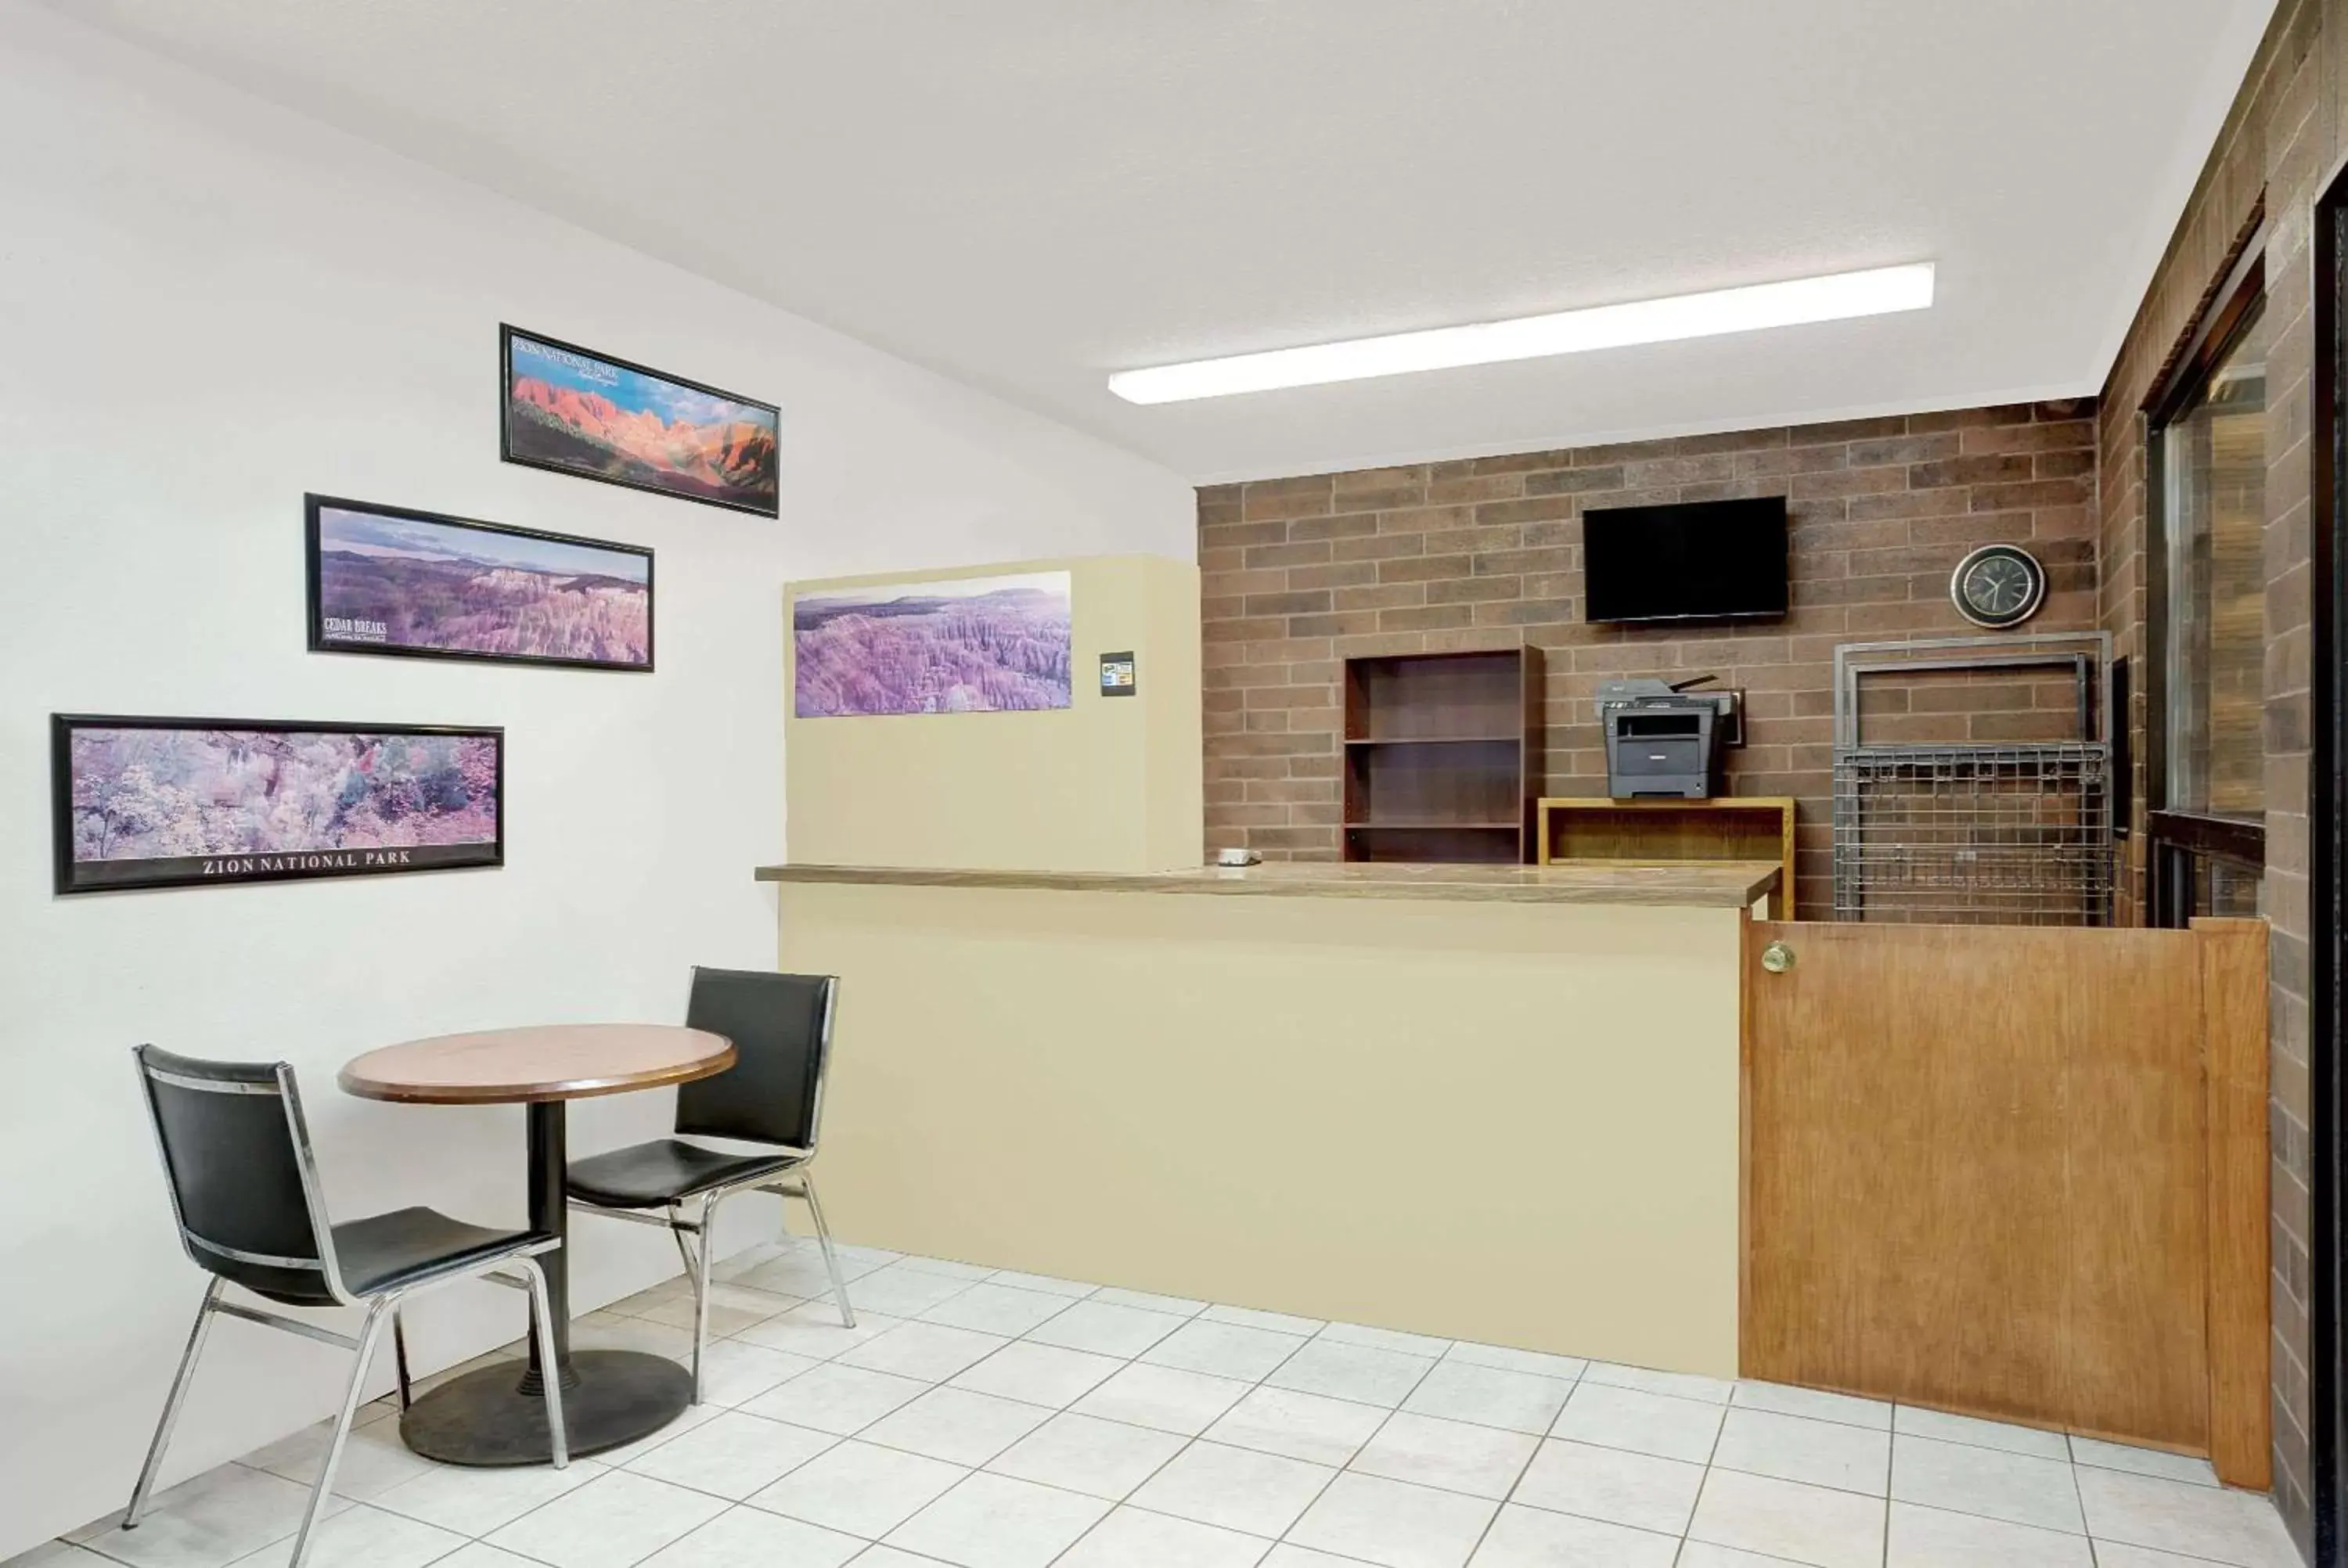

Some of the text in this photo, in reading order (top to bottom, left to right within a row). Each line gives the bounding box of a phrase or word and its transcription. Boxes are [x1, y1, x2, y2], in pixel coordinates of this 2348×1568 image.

[593, 361, 618, 377] PARK
[324, 617, 388, 635] CEDAR BREAKS
[203, 851, 411, 874] ZION NATIONAL PARK
